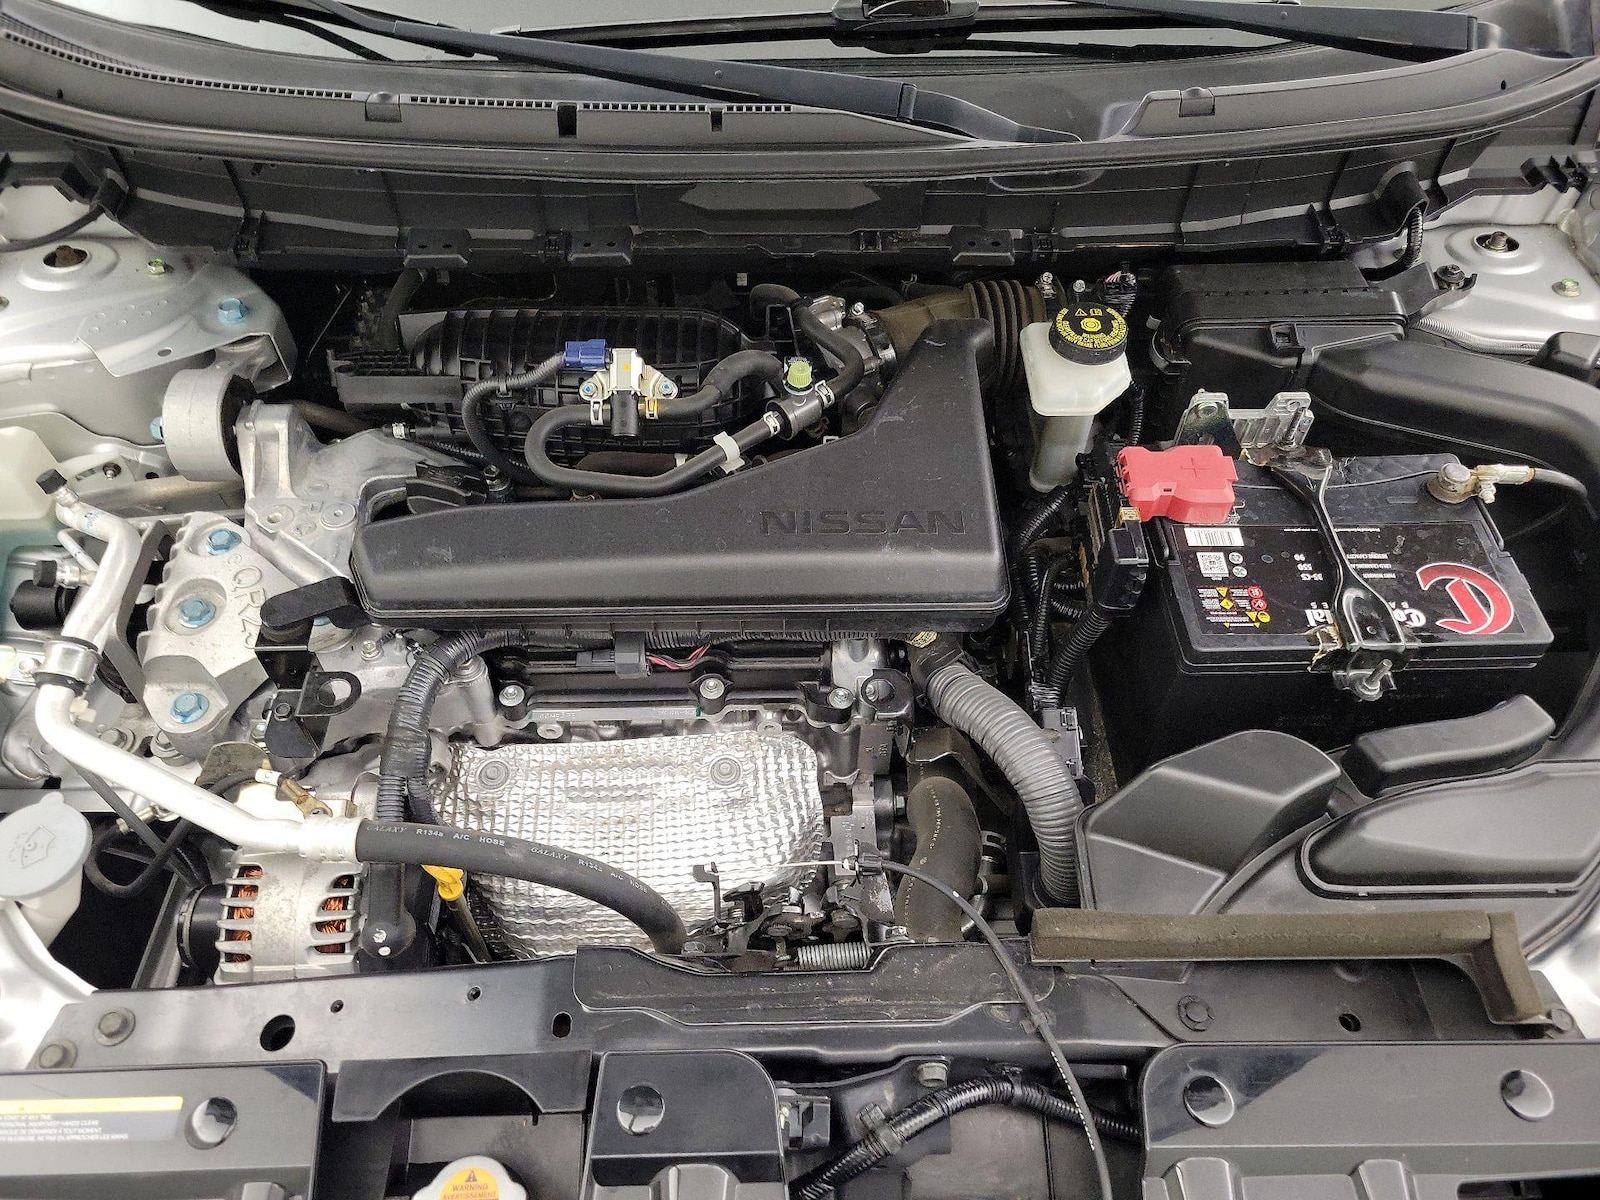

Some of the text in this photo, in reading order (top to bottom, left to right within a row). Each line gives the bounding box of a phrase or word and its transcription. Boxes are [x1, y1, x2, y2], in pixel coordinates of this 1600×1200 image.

[760, 510, 965, 535] NISSAN
[416, 828, 444, 838] R134a
[453, 833, 470, 841] A/C
[479, 836, 505, 848] HOSE
[530, 845, 570, 861] GALAXY
[452, 1183, 488, 1192] WARNING
